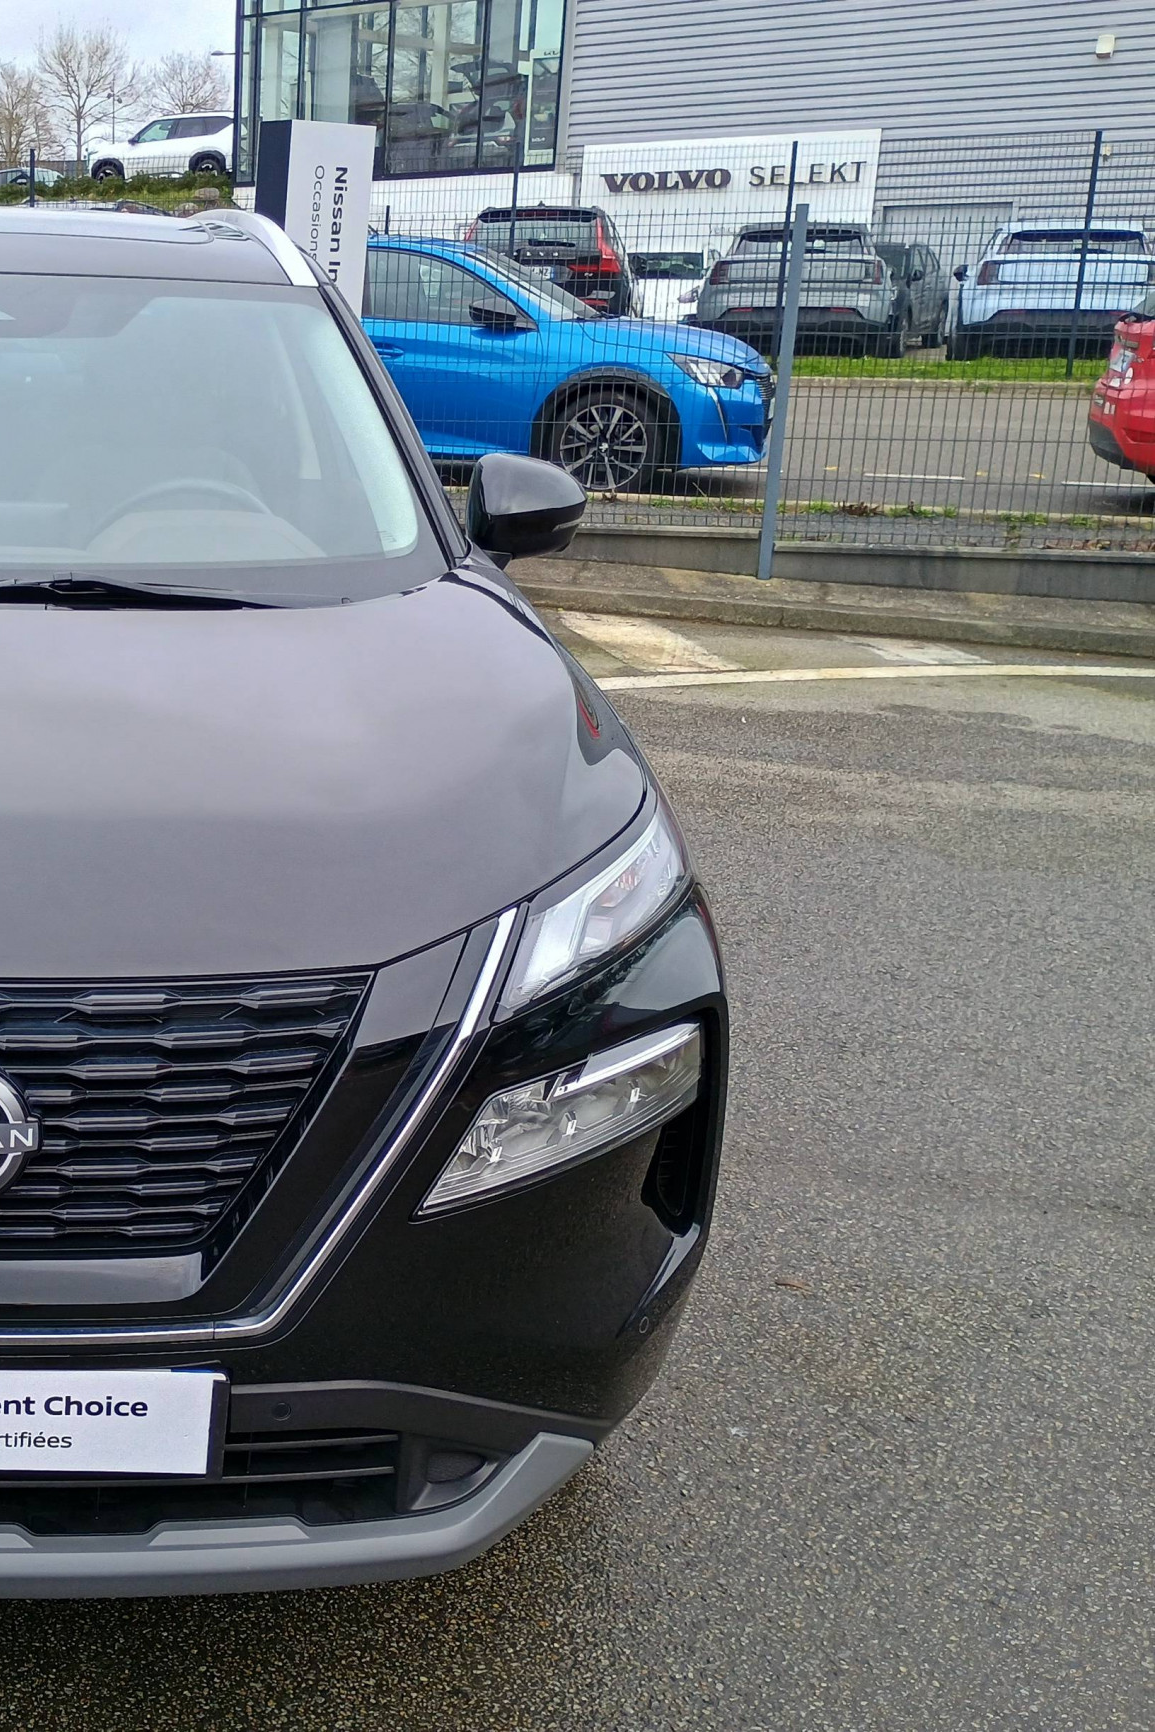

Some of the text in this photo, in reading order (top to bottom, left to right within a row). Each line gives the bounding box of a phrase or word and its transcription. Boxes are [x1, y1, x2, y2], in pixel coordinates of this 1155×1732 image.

[600, 168, 732, 193] VOLVO
[309, 165, 325, 261] Occasions
[329, 166, 348, 253] Nissan
[43, 1395, 149, 1418] Choice
